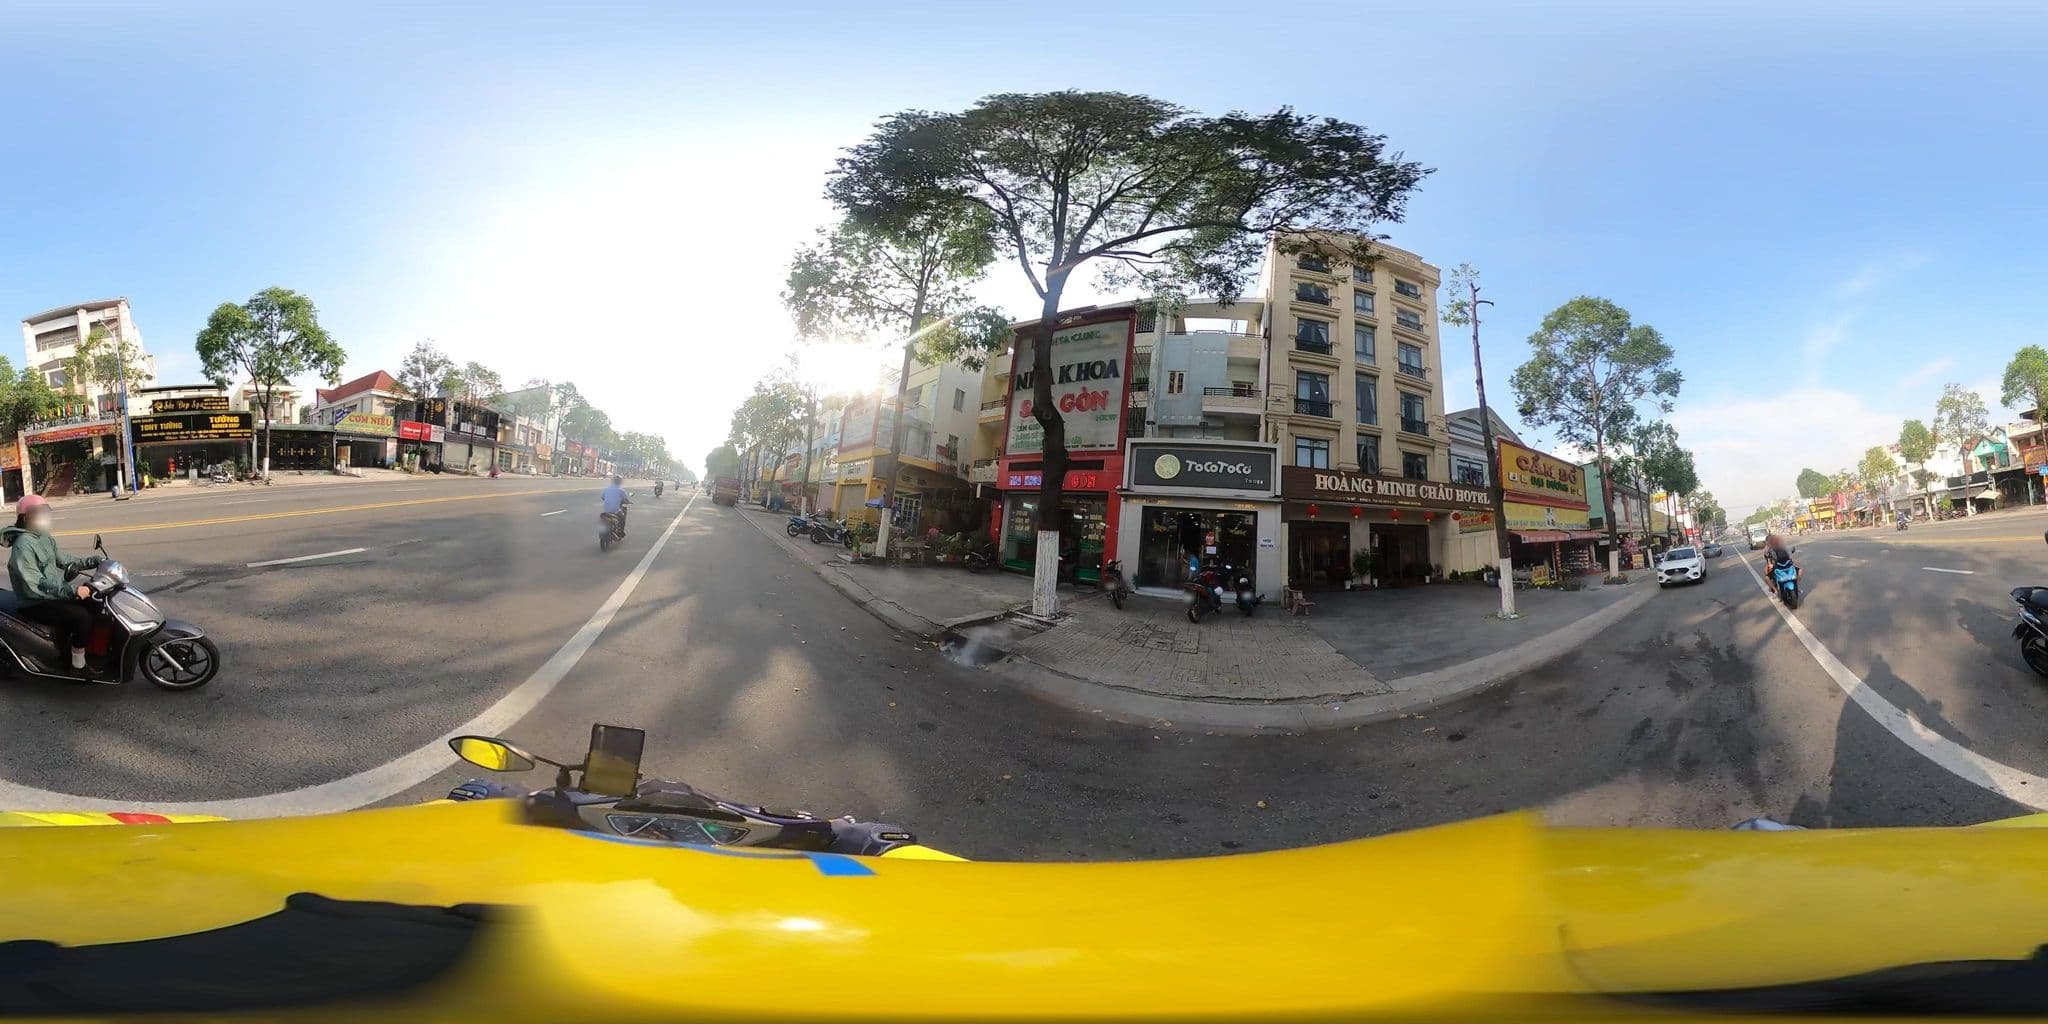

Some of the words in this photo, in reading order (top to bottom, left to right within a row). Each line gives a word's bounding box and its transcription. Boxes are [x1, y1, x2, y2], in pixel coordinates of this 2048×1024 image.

[1058, 359, 1120, 384] KHOA
[1060, 387, 1110, 413] GÒN
[1314, 471, 1374, 493] HOÀNG
[1376, 480, 1417, 498] MINH
[1419, 483, 1453, 502] CHÂU
[1455, 489, 1491, 505] HOTEL
